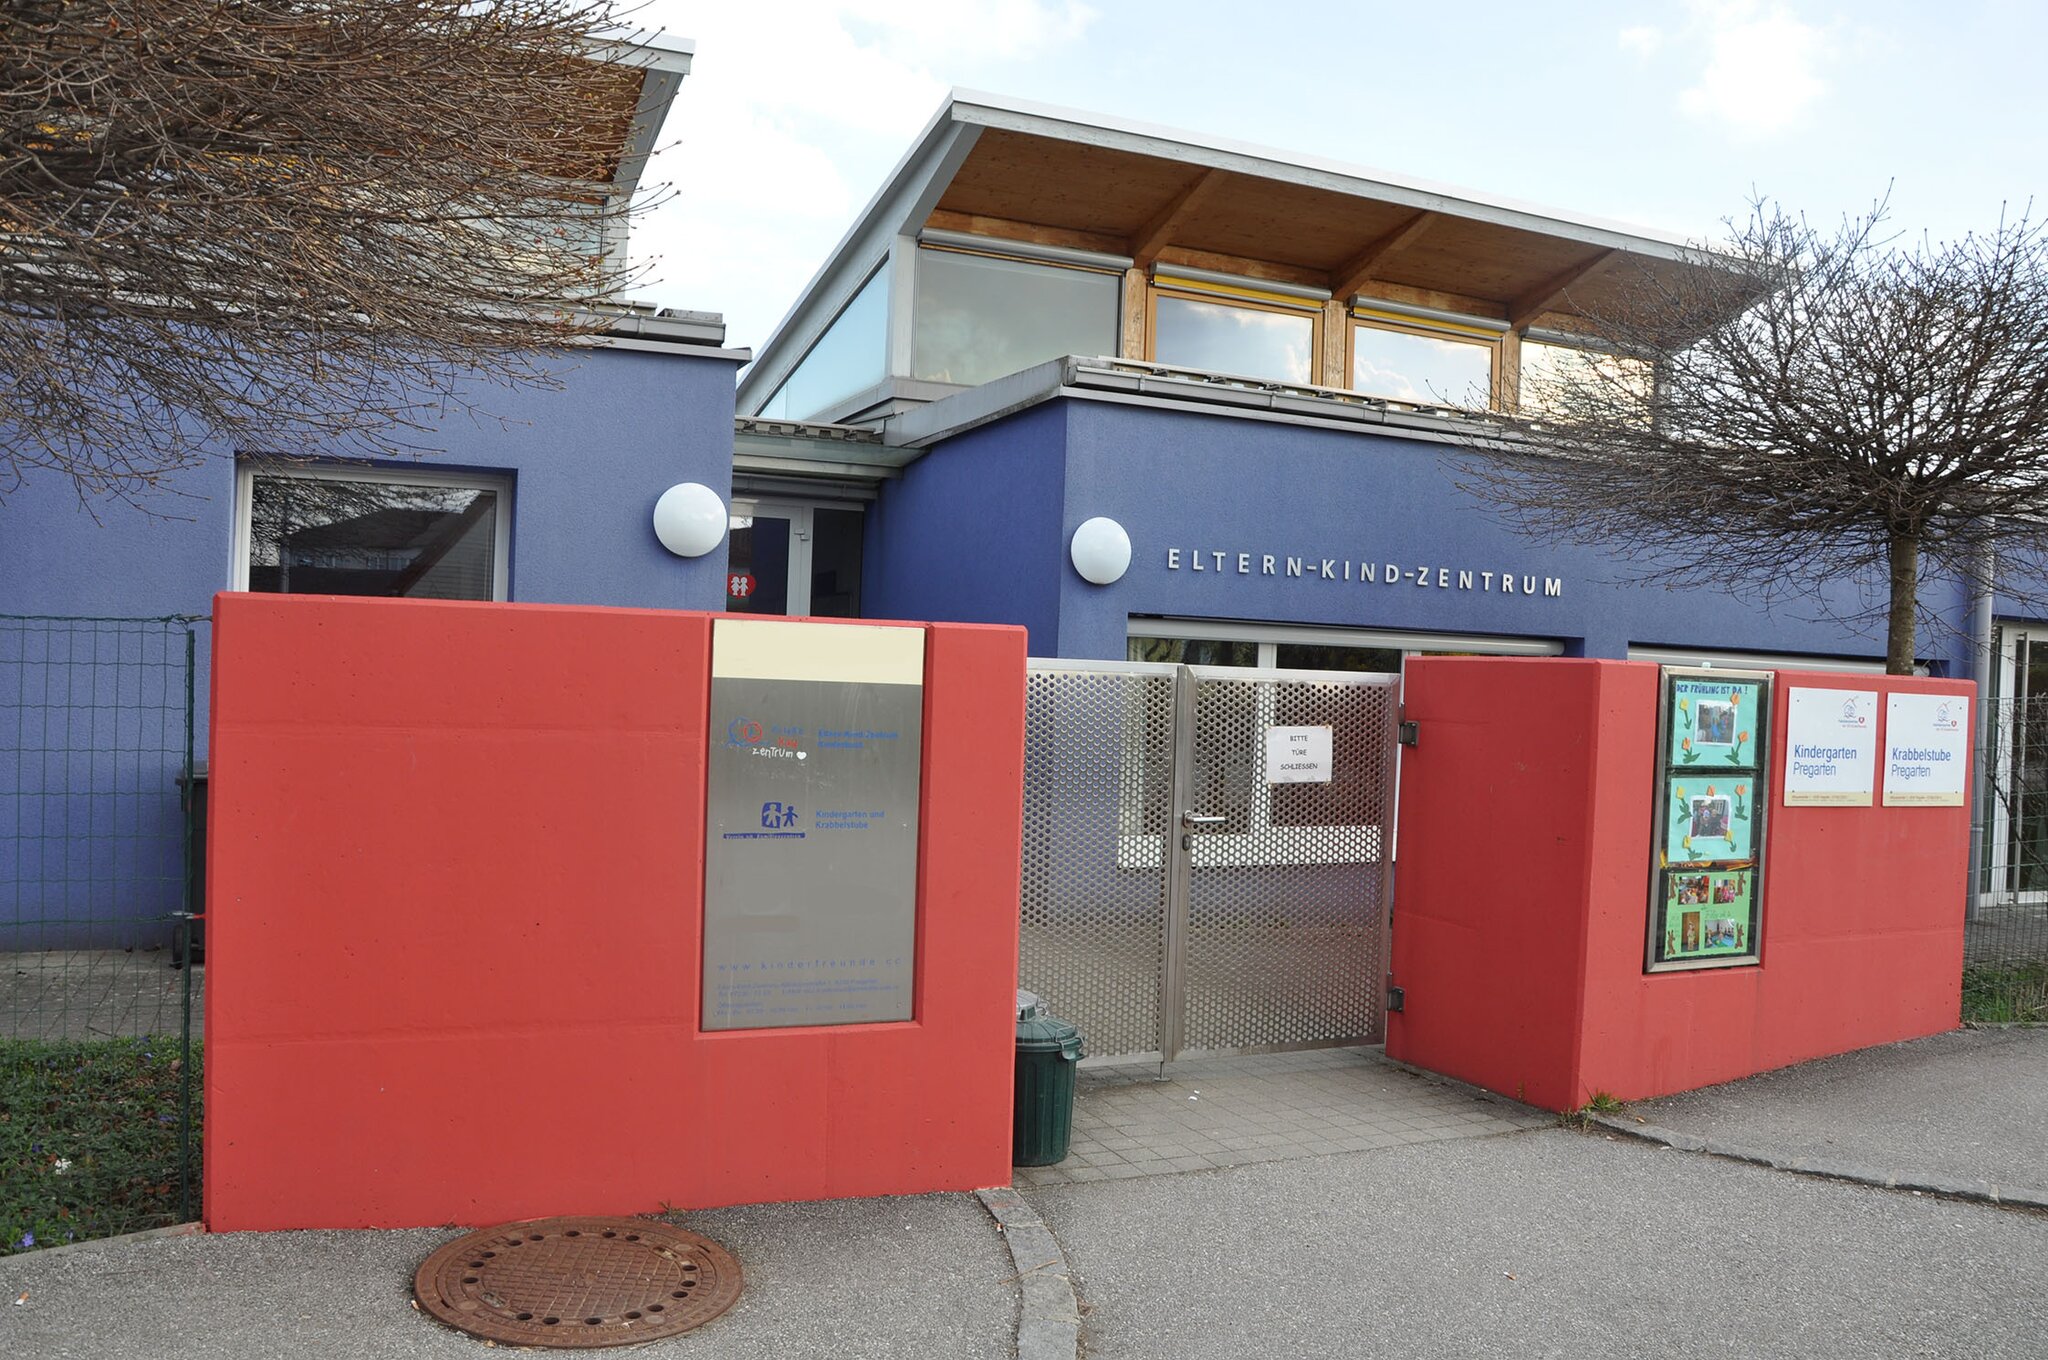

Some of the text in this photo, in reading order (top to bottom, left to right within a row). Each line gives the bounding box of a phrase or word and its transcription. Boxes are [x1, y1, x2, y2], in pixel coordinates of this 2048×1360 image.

[1168, 548, 1562, 597] ELTERN-KIND-ZENTRUM
[1676, 684, 1688, 693] DER
[1690, 683, 1719, 695] FRÜHLING
[1720, 686, 1731, 695] IST
[1732, 686, 1743, 695] DA
[1292, 748, 1307, 756] TÜRE
[1794, 744, 1857, 762] Kindergarten
[1892, 747, 1952, 762] Krabbelstube
[1793, 761, 1836, 778] Pregarten
[1891, 763, 1931, 780] Pregarten
[815, 809, 885, 819] Kindergarten und
[815, 821, 869, 829] Krabbelstube
